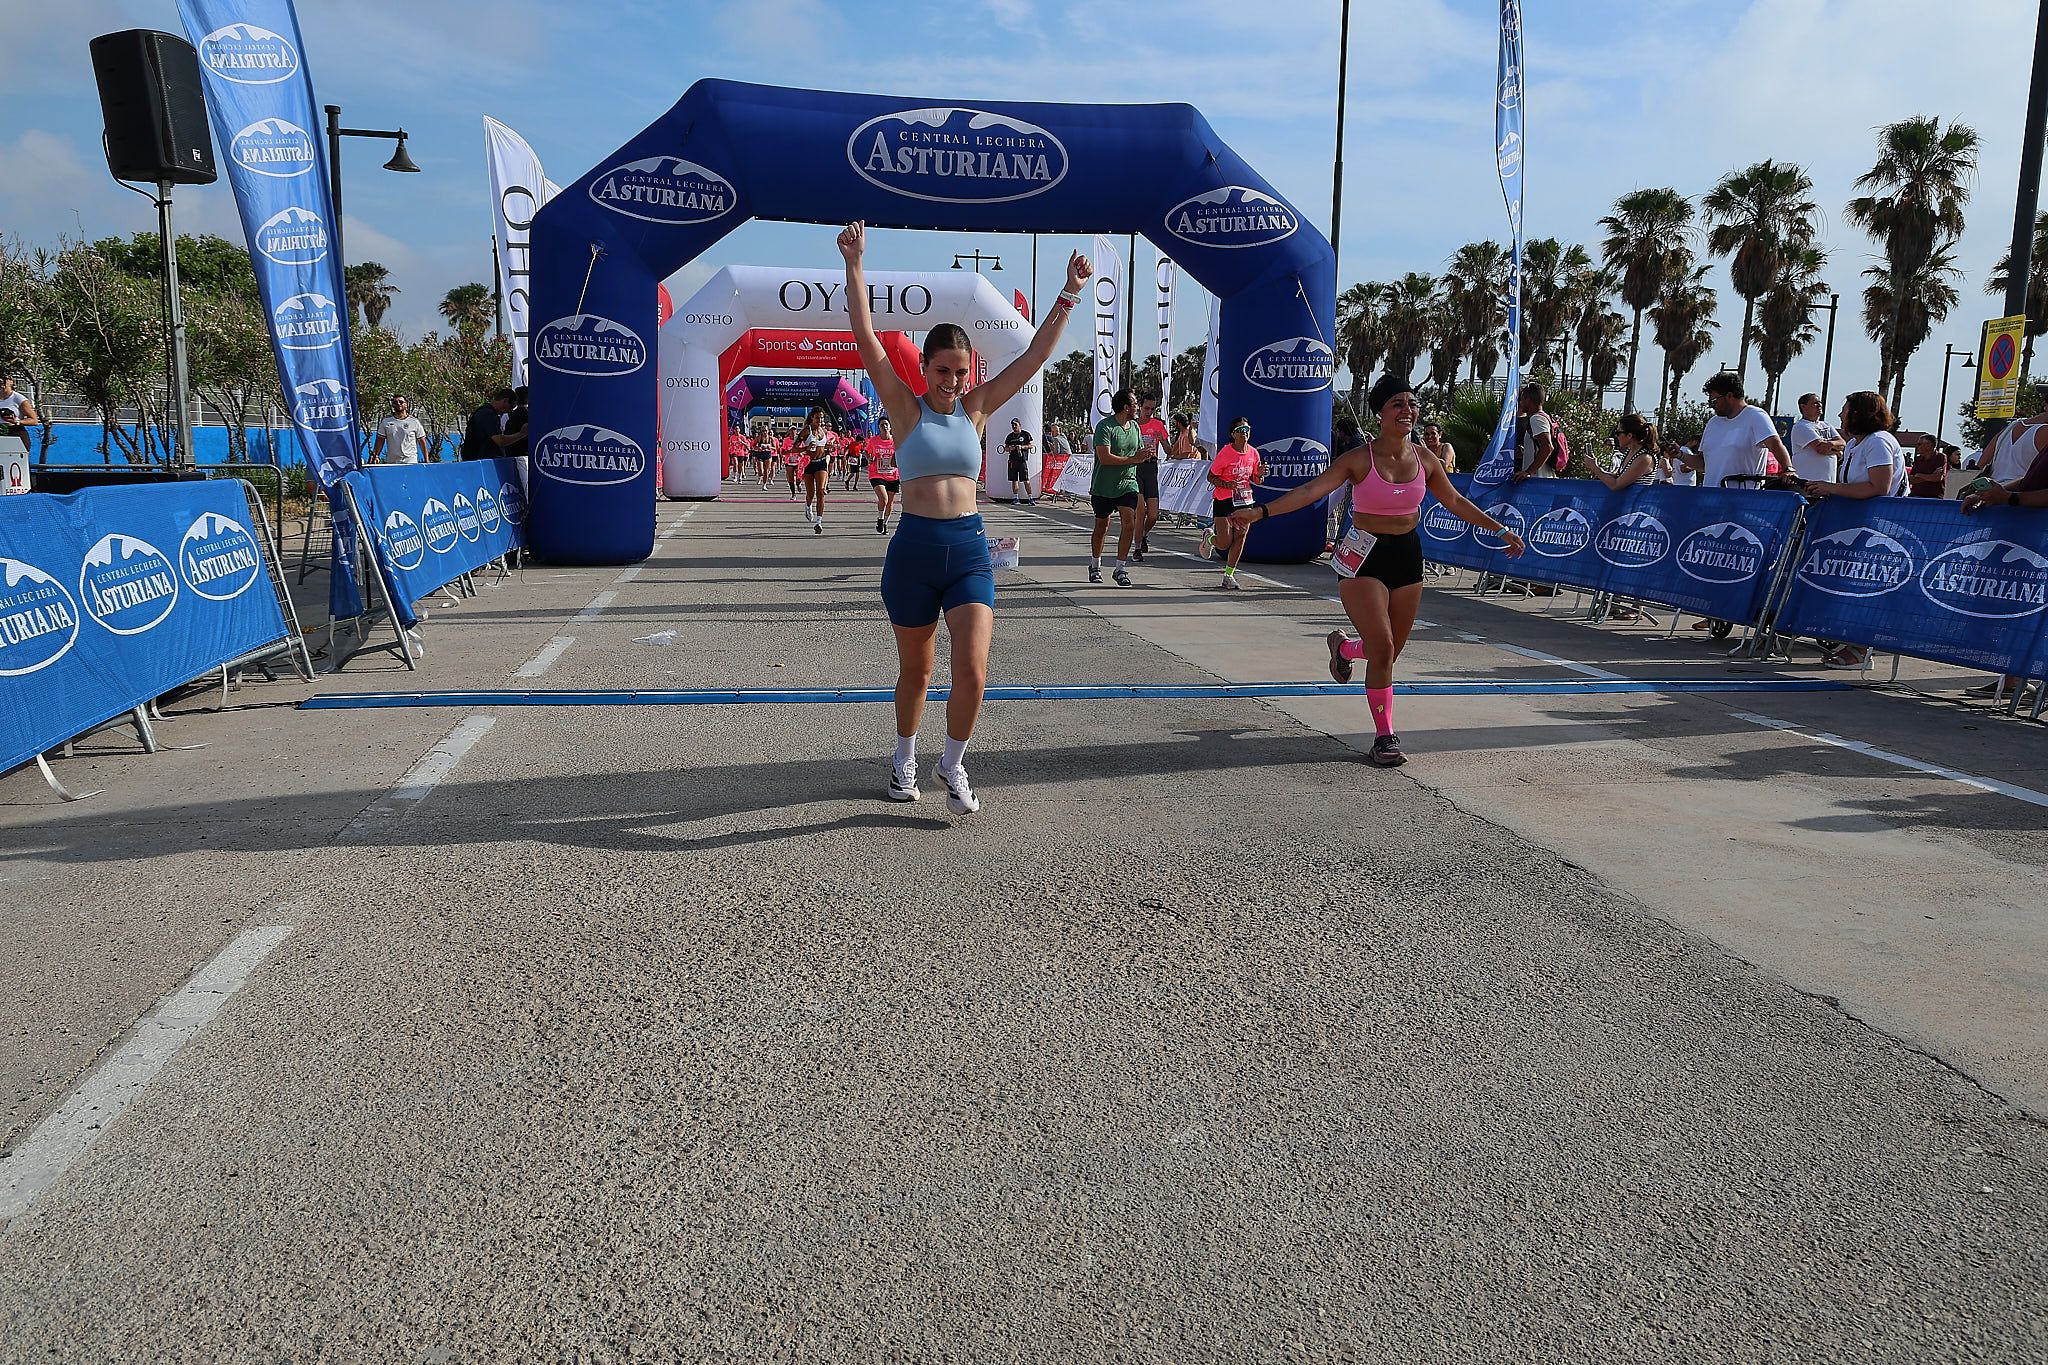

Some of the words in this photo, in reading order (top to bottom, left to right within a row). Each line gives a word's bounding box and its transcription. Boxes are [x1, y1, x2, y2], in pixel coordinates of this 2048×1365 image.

[900, 131, 969, 145] CENTRAL
[976, 136, 1045, 148] LECHERA
[864, 131, 1052, 181] ASTURIANA
[598, 177, 725, 211] ASTURIANA
[623, 175, 672, 187] CENTRAL
[676, 180, 724, 193] LECHERA
[1176, 211, 1293, 234] ASTURIANA
[1197, 207, 1242, 216] CENTRAL
[778, 280, 932, 316] OYHO
[685, 314, 733, 326] OYSHO
[975, 320, 1019, 330] OYSHO
[540, 335, 640, 364] ASTURIANA
[554, 333, 594, 342] CENTRAL
[598, 336, 637, 346] LECHERA
[758, 338, 797, 353] Sports
[815, 340, 858, 351] Santan
[666, 378, 710, 388] OYSHO
[554, 443, 593, 452] CENTRAL
[597, 445, 636, 455] LECHERA
[667, 441, 711, 451] OYSHO
[540, 444, 639, 472] ASTURIANA
[1531, 523, 1583, 546] ASTURIANA
[1598, 529, 1662, 557] ASTURIANA
[1680, 540, 1755, 573] ASTURIANA
[1800, 548, 1899, 584] ASTURIANA
[96, 567, 129, 584] CENTRAL
[129, 559, 162, 575] LECHERA
[1954, 563, 1998, 575] CENTRAL
[90, 571, 174, 617] ASTURIANA
[1926, 562, 2046, 604] ASTURIANA
